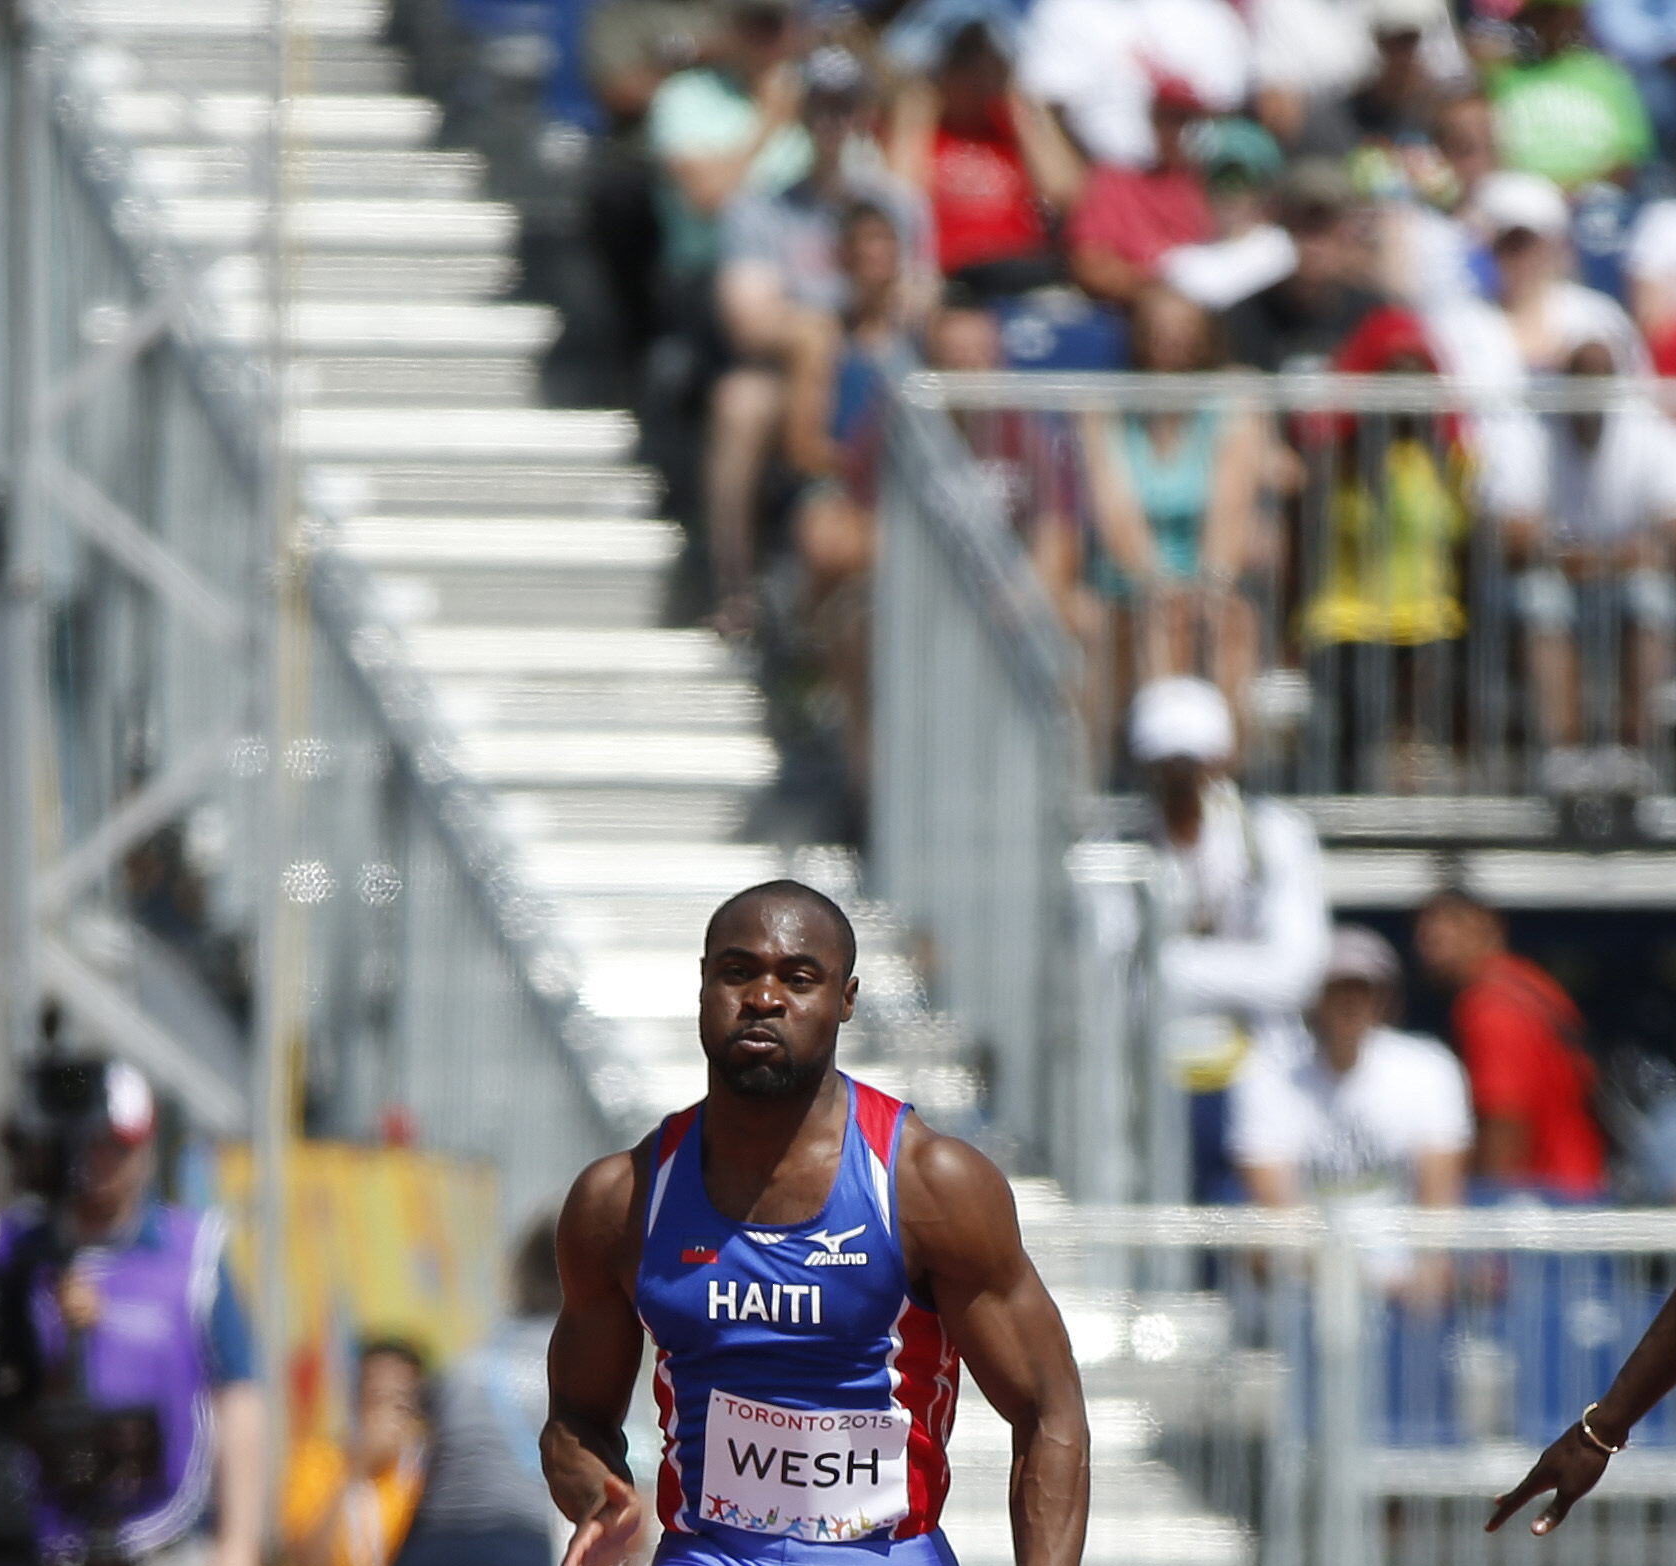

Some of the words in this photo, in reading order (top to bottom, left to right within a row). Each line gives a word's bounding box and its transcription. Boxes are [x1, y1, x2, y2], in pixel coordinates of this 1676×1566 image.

[708, 1280, 821, 1324] HAITI
[726, 1399, 836, 1432] TORONTO
[838, 1415, 893, 1430] 2015
[727, 1437, 879, 1488] WESH
